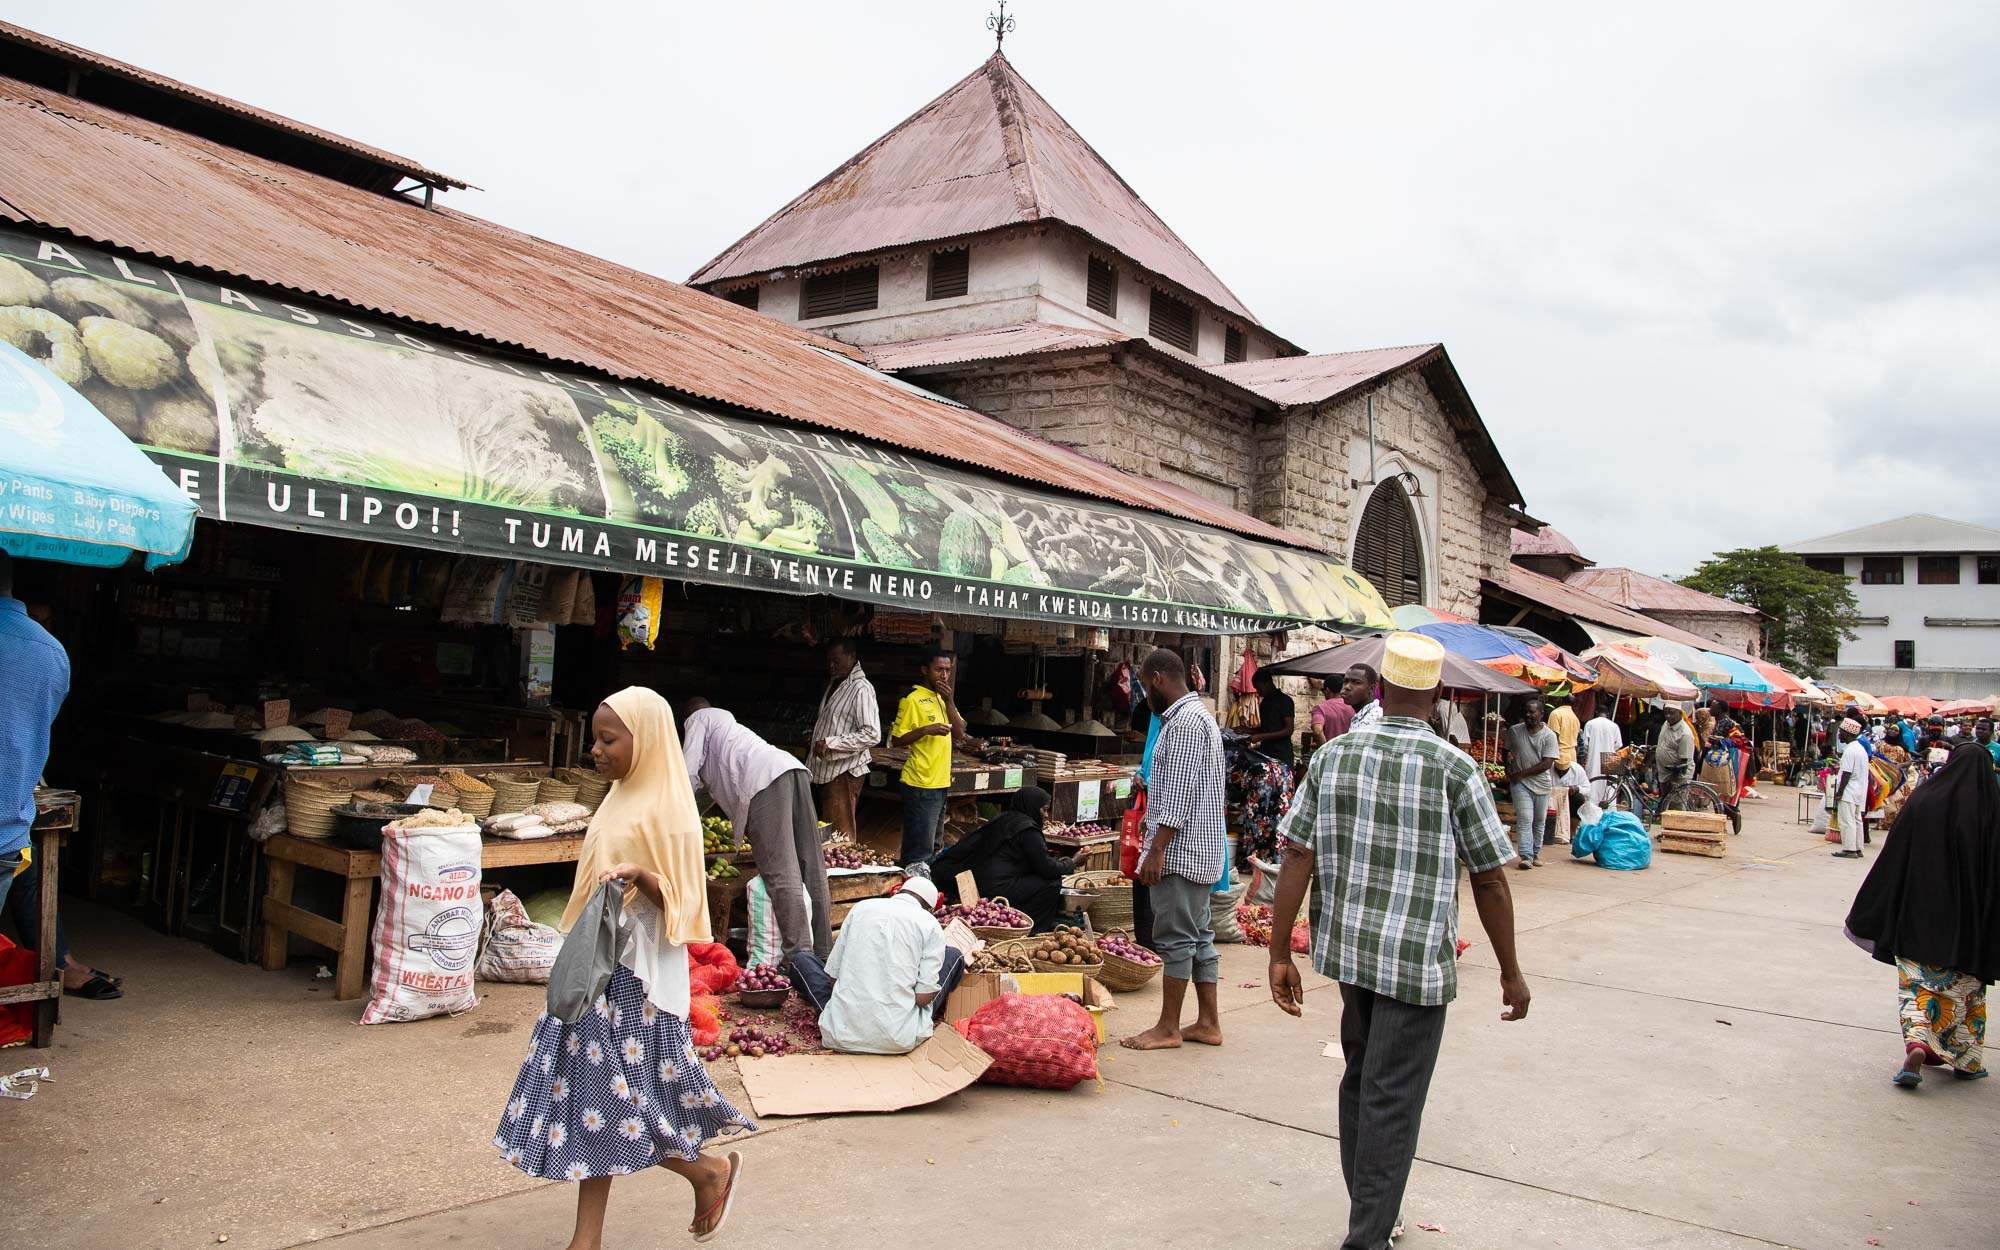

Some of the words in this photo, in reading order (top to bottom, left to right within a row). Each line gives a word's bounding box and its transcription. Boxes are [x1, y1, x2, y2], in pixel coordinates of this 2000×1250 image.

[12, 480, 53, 501] Pants
[10, 503, 55, 525] Wipes
[75, 490, 106, 513] Baby
[110, 497, 160, 521] Diapers
[75, 511, 103, 535] Lady
[108, 518, 136, 537] Pads
[267, 481, 461, 537] ULIPO!!
[504, 518, 612, 557] TUMA
[635, 537, 753, 577] MESEJI
[770, 557, 855, 591] YENYE
[869, 573, 932, 600] NENO
[1039, 594, 1112, 619] KWENDA
[1121, 605, 1168, 624] 15670
[1176, 610, 1218, 629] KISHA
[1223, 615, 1261, 632] FUATA
[409, 882, 464, 901] NGANO
[402, 971, 454, 989] WHEAT
